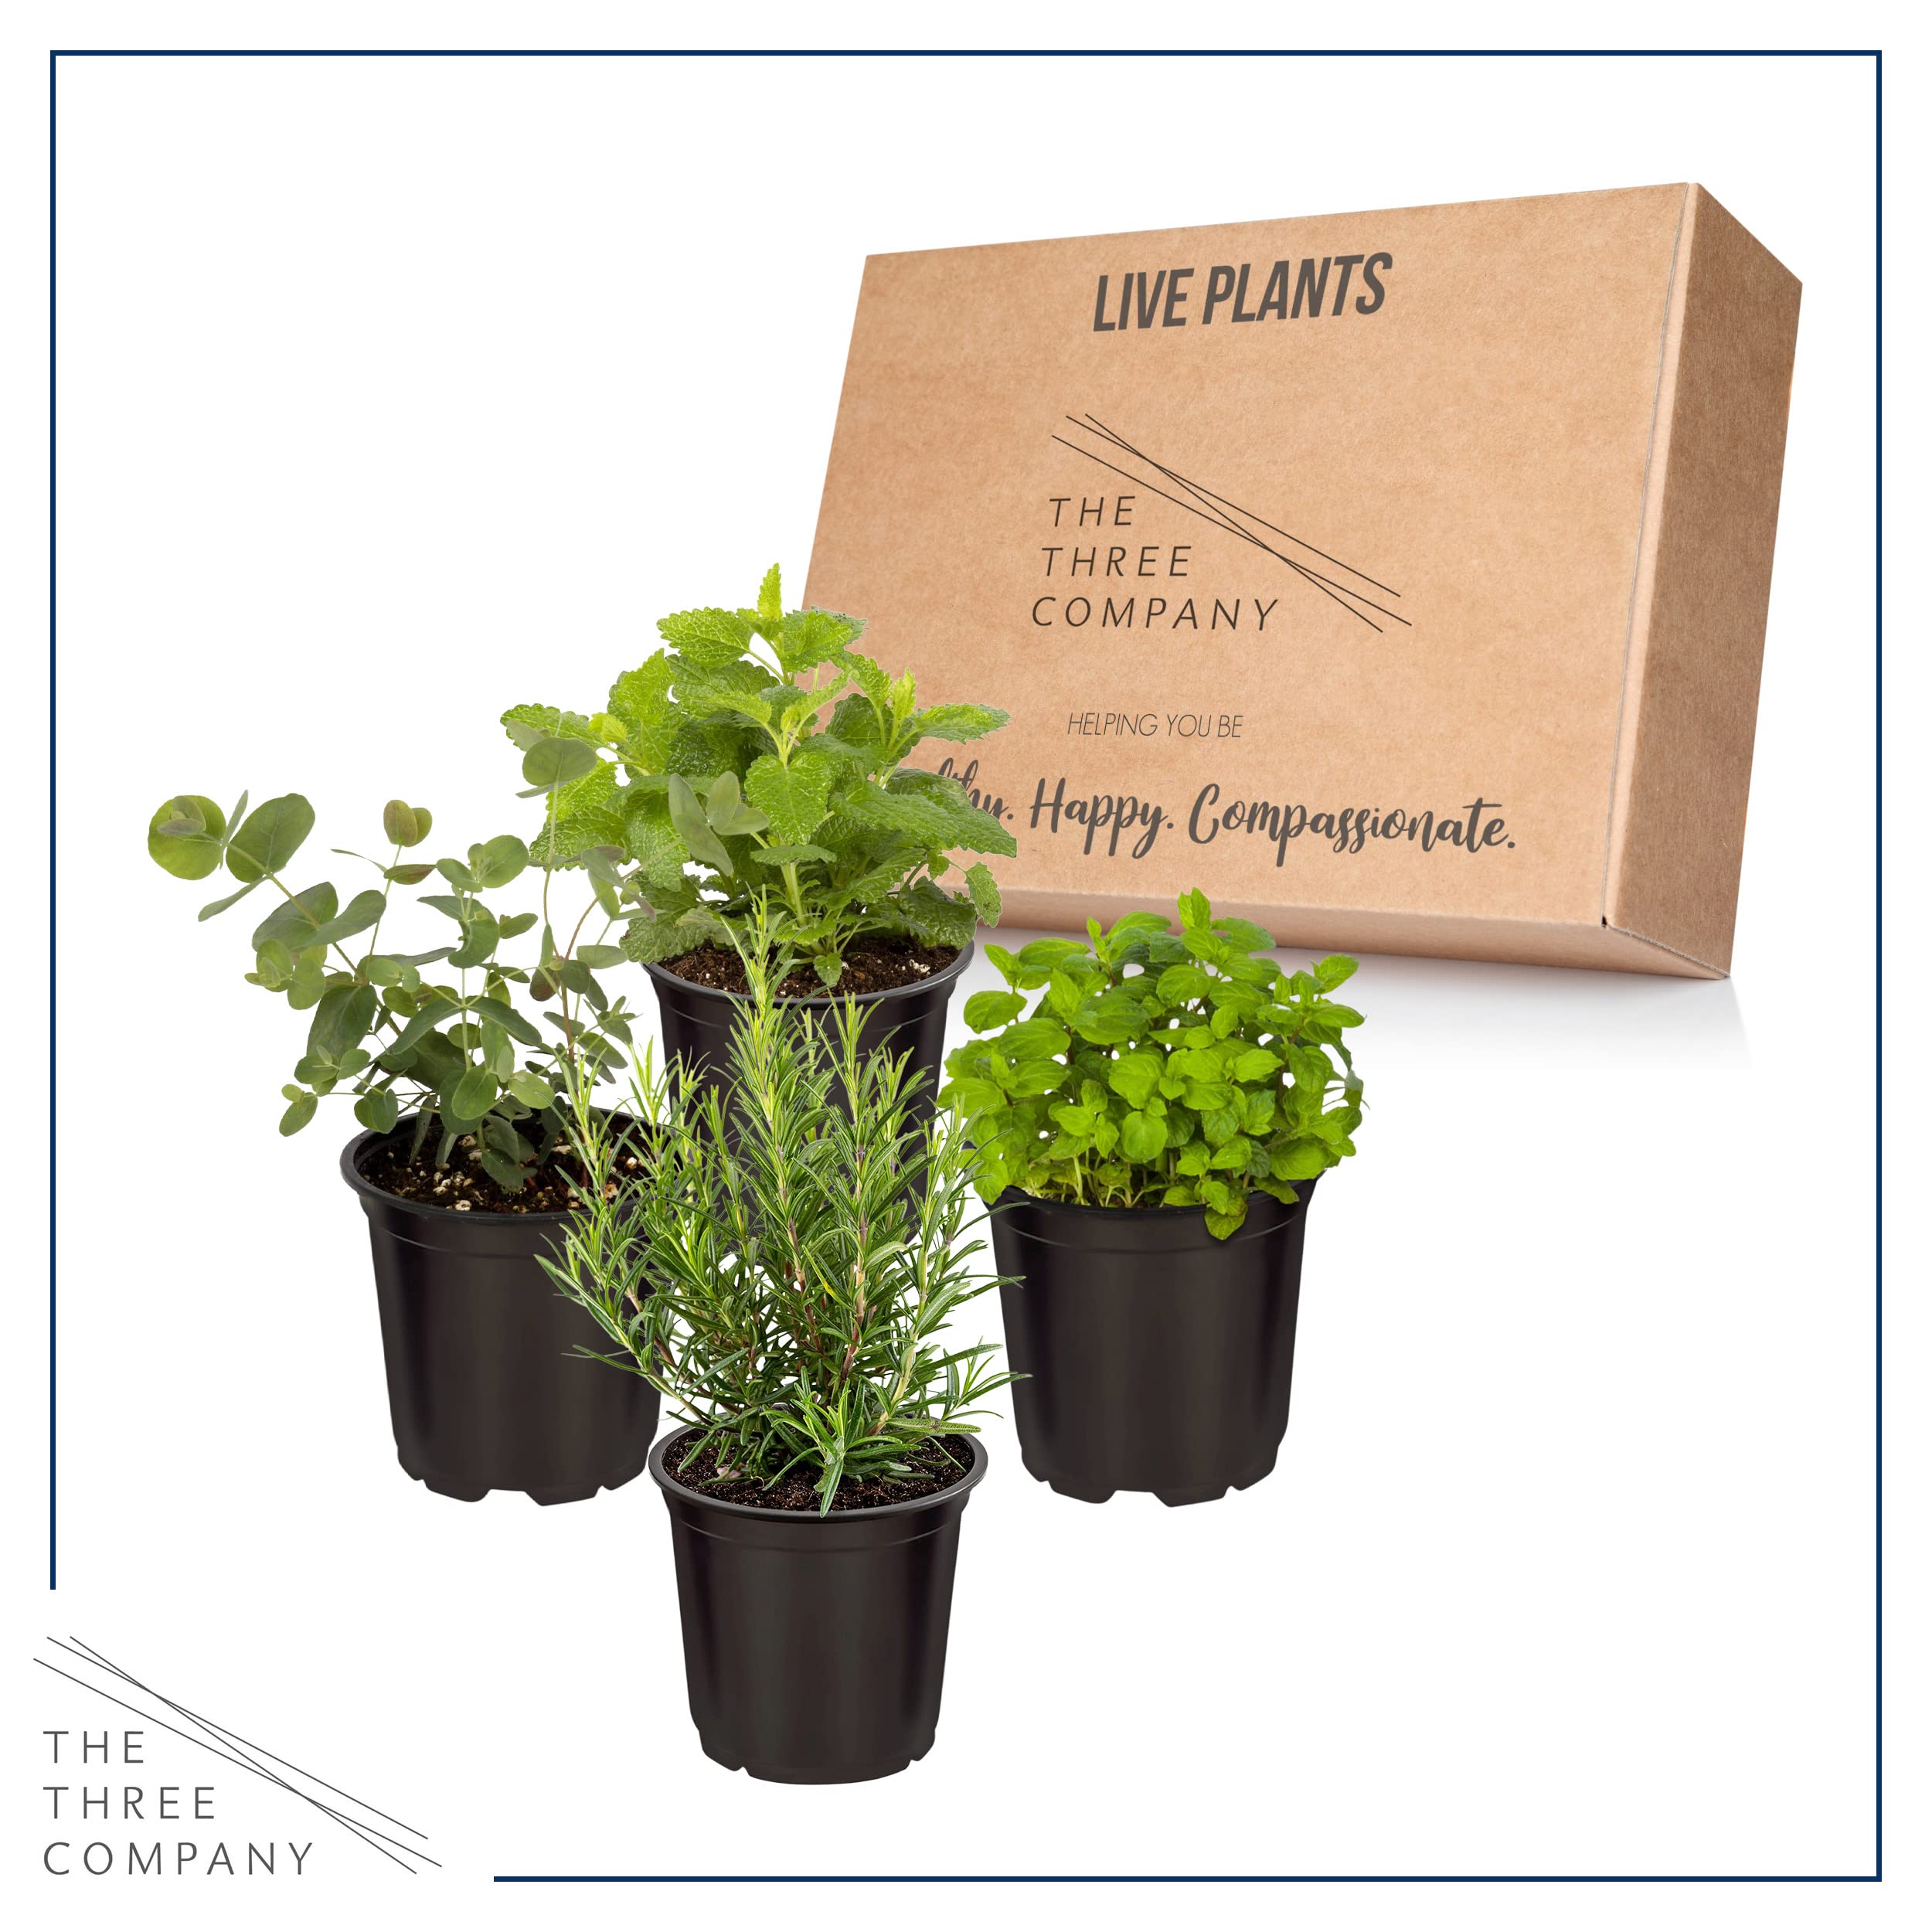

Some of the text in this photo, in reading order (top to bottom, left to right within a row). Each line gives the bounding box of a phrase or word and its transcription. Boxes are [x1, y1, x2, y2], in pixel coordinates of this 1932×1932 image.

[1093, 252, 1393, 332] LIVE PLANTS
[1049, 495, 1135, 527] THE
[1041, 546, 1192, 577] THREE
[1032, 597, 1278, 631] COMPANY
[1067, 713, 1243, 738] HELPING YOU BE
[1029, 777, 1174, 859] Happy.
[1189, 783, 1515, 867] Compassionate.
